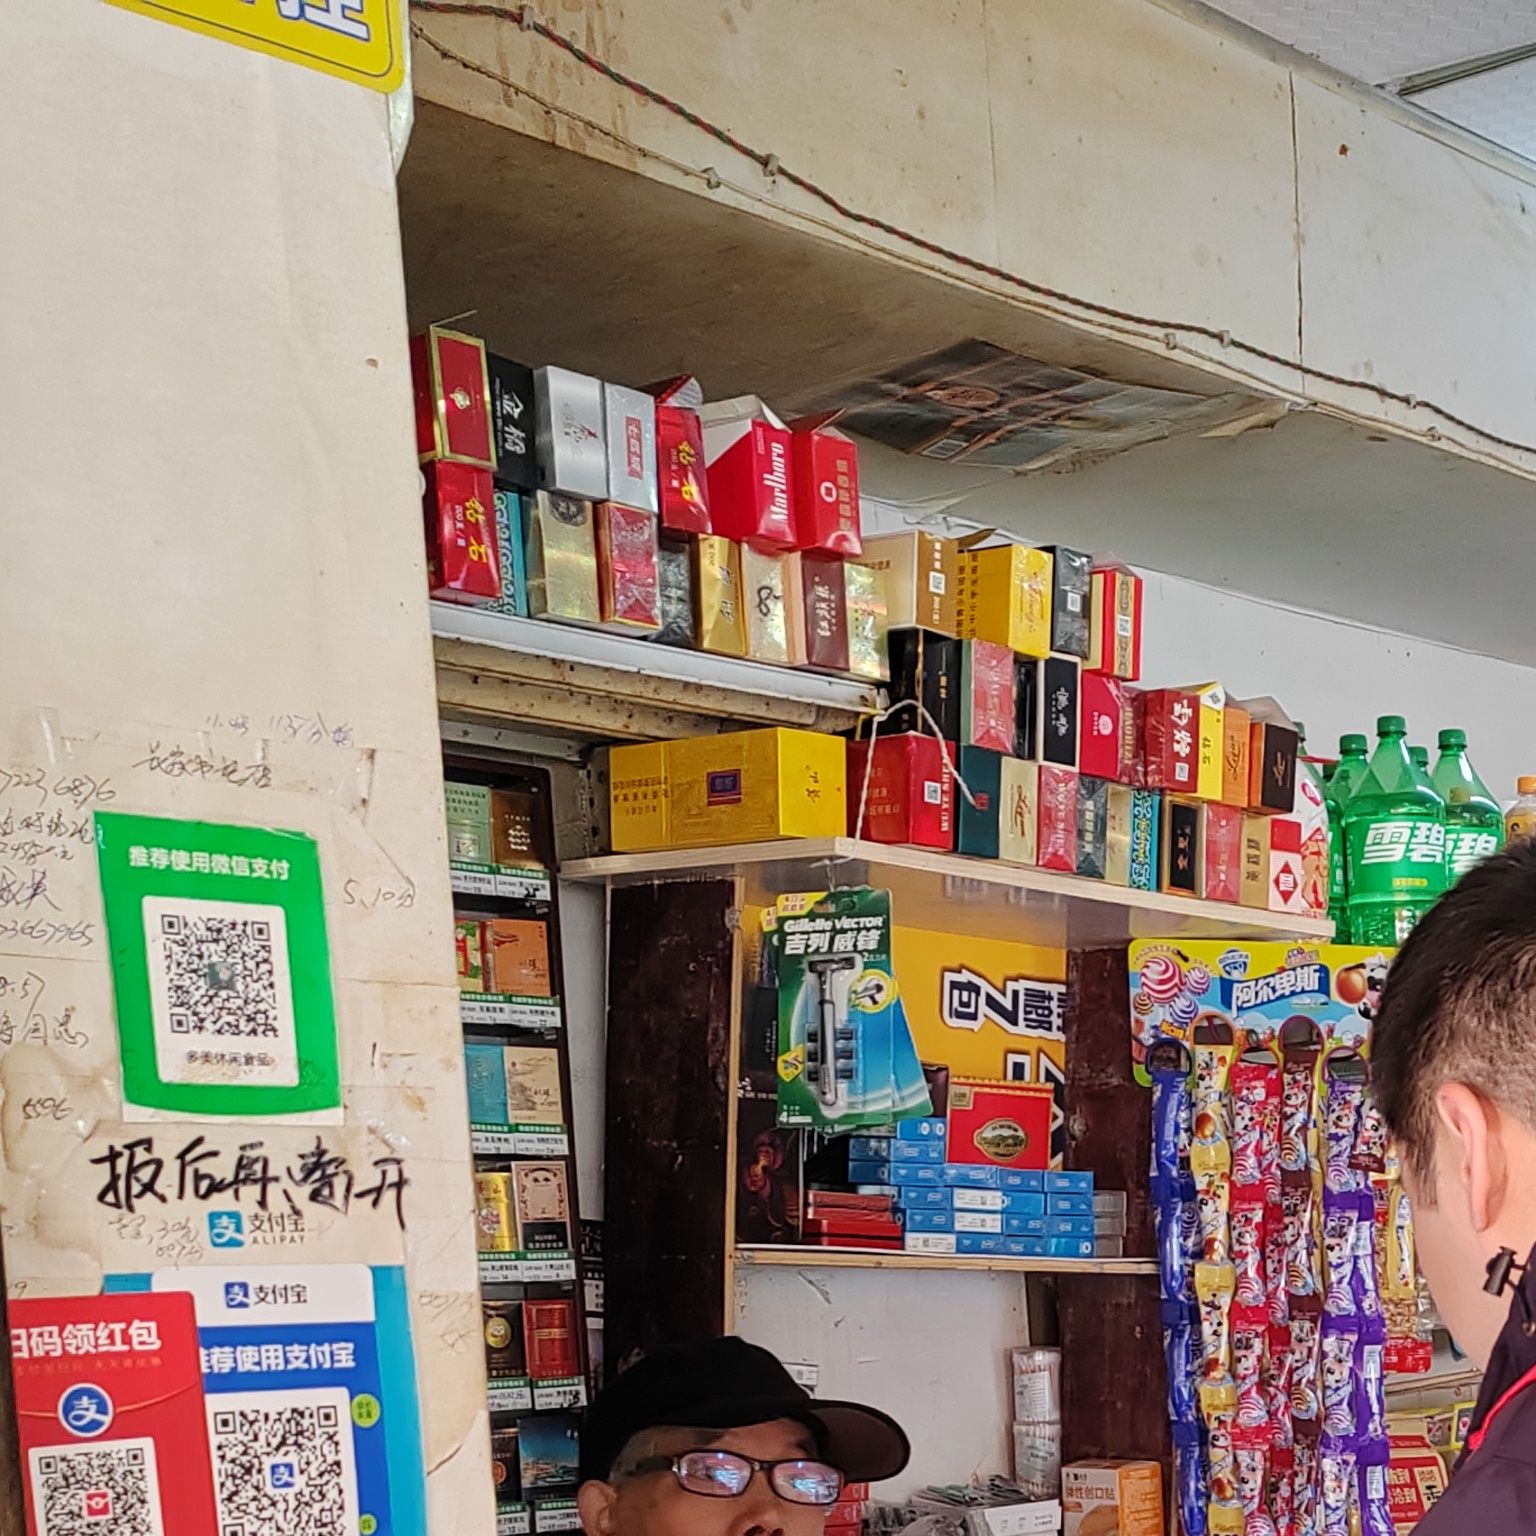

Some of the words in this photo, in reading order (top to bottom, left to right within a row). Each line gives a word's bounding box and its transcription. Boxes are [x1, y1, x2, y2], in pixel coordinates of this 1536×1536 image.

[758, 441, 788, 526] Marlboro
[1361, 821, 1446, 866] 雪碧
[128, 846, 291, 881] 推荐使用微信支付
[783, 918, 834, 933] Gillette
[834, 915, 884, 930] VECTOR
[784, 931, 831, 956] 吉列
[1232, 964, 1321, 1018] 阿尔卑斯
[249, 1211, 305, 1234] 支付宝
[251, 1235, 306, 1247] ALIPAY
[253, 1283, 308, 1305] 支付宝
